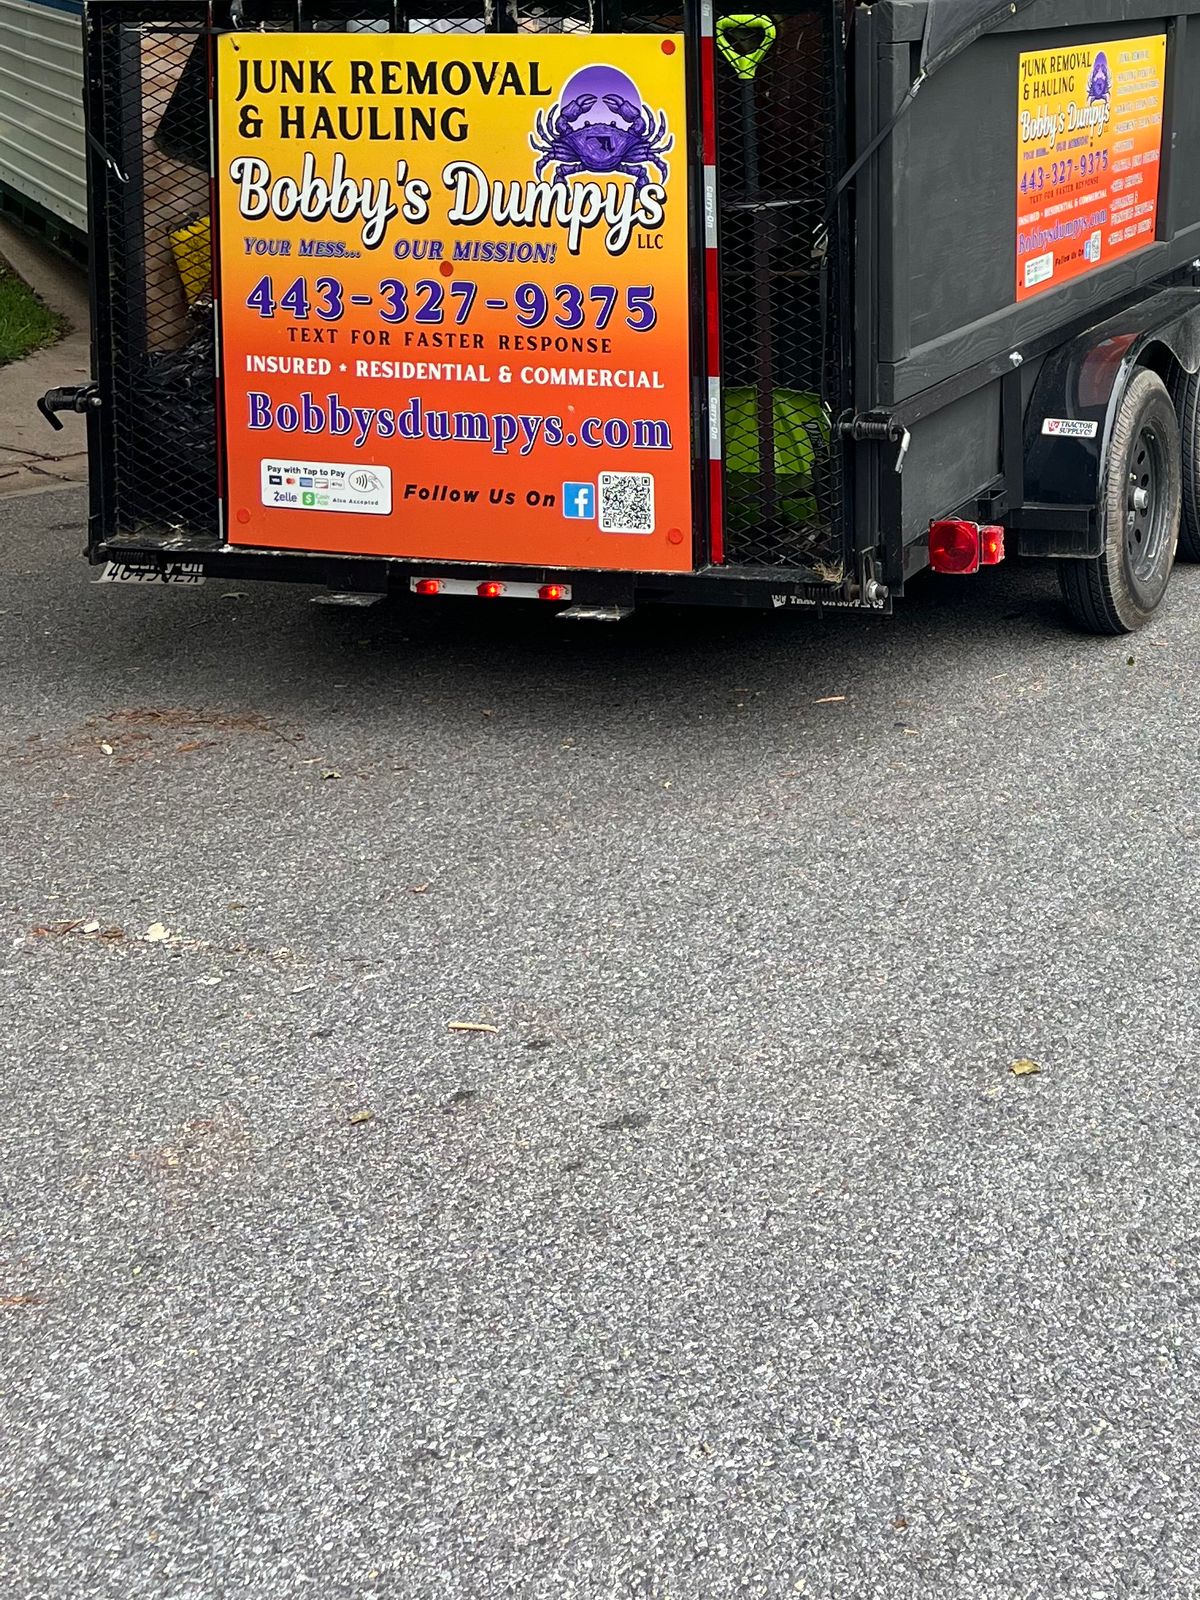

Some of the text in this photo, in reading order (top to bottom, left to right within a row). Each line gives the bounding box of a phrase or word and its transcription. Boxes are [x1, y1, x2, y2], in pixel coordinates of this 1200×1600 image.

[235, 59, 552, 101] JUNK REMOVAL
[1021, 57, 1047, 82] JUNK
[1050, 51, 1092, 74] REMOVAL
[1023, 75, 1075, 101] & HAULING
[239, 104, 470, 142] & HAULING
[1020, 103, 1066, 150] Bobby's
[1068, 101, 1111, 139] Dumpys
[1020, 148, 1109, 195] 443-327-9375
[230, 151, 667, 257] Bobby's Dumpys
[243, 236, 558, 264] YOUR MESS... OUR MISSION!
[637, 233, 664, 250] LLC
[245, 274, 659, 332] 443-327-9375
[287, 326, 614, 355] TEXT FOR FASTER RESPONSE
[245, 354, 665, 390] INSURED RESIDENTIAL & COMMERCIAL
[246, 390, 673, 457] Bobbysdumpys.com
[1059, 427, 1084, 435] SUPPLY
[1061, 420, 1094, 430] TRACTOR
[267, 464, 346, 479] Pay with Tap to Pay
[273, 491, 298, 503] Zelle
[348, 498, 380, 506] Accepted
[403, 483, 557, 508] Follow Us On
